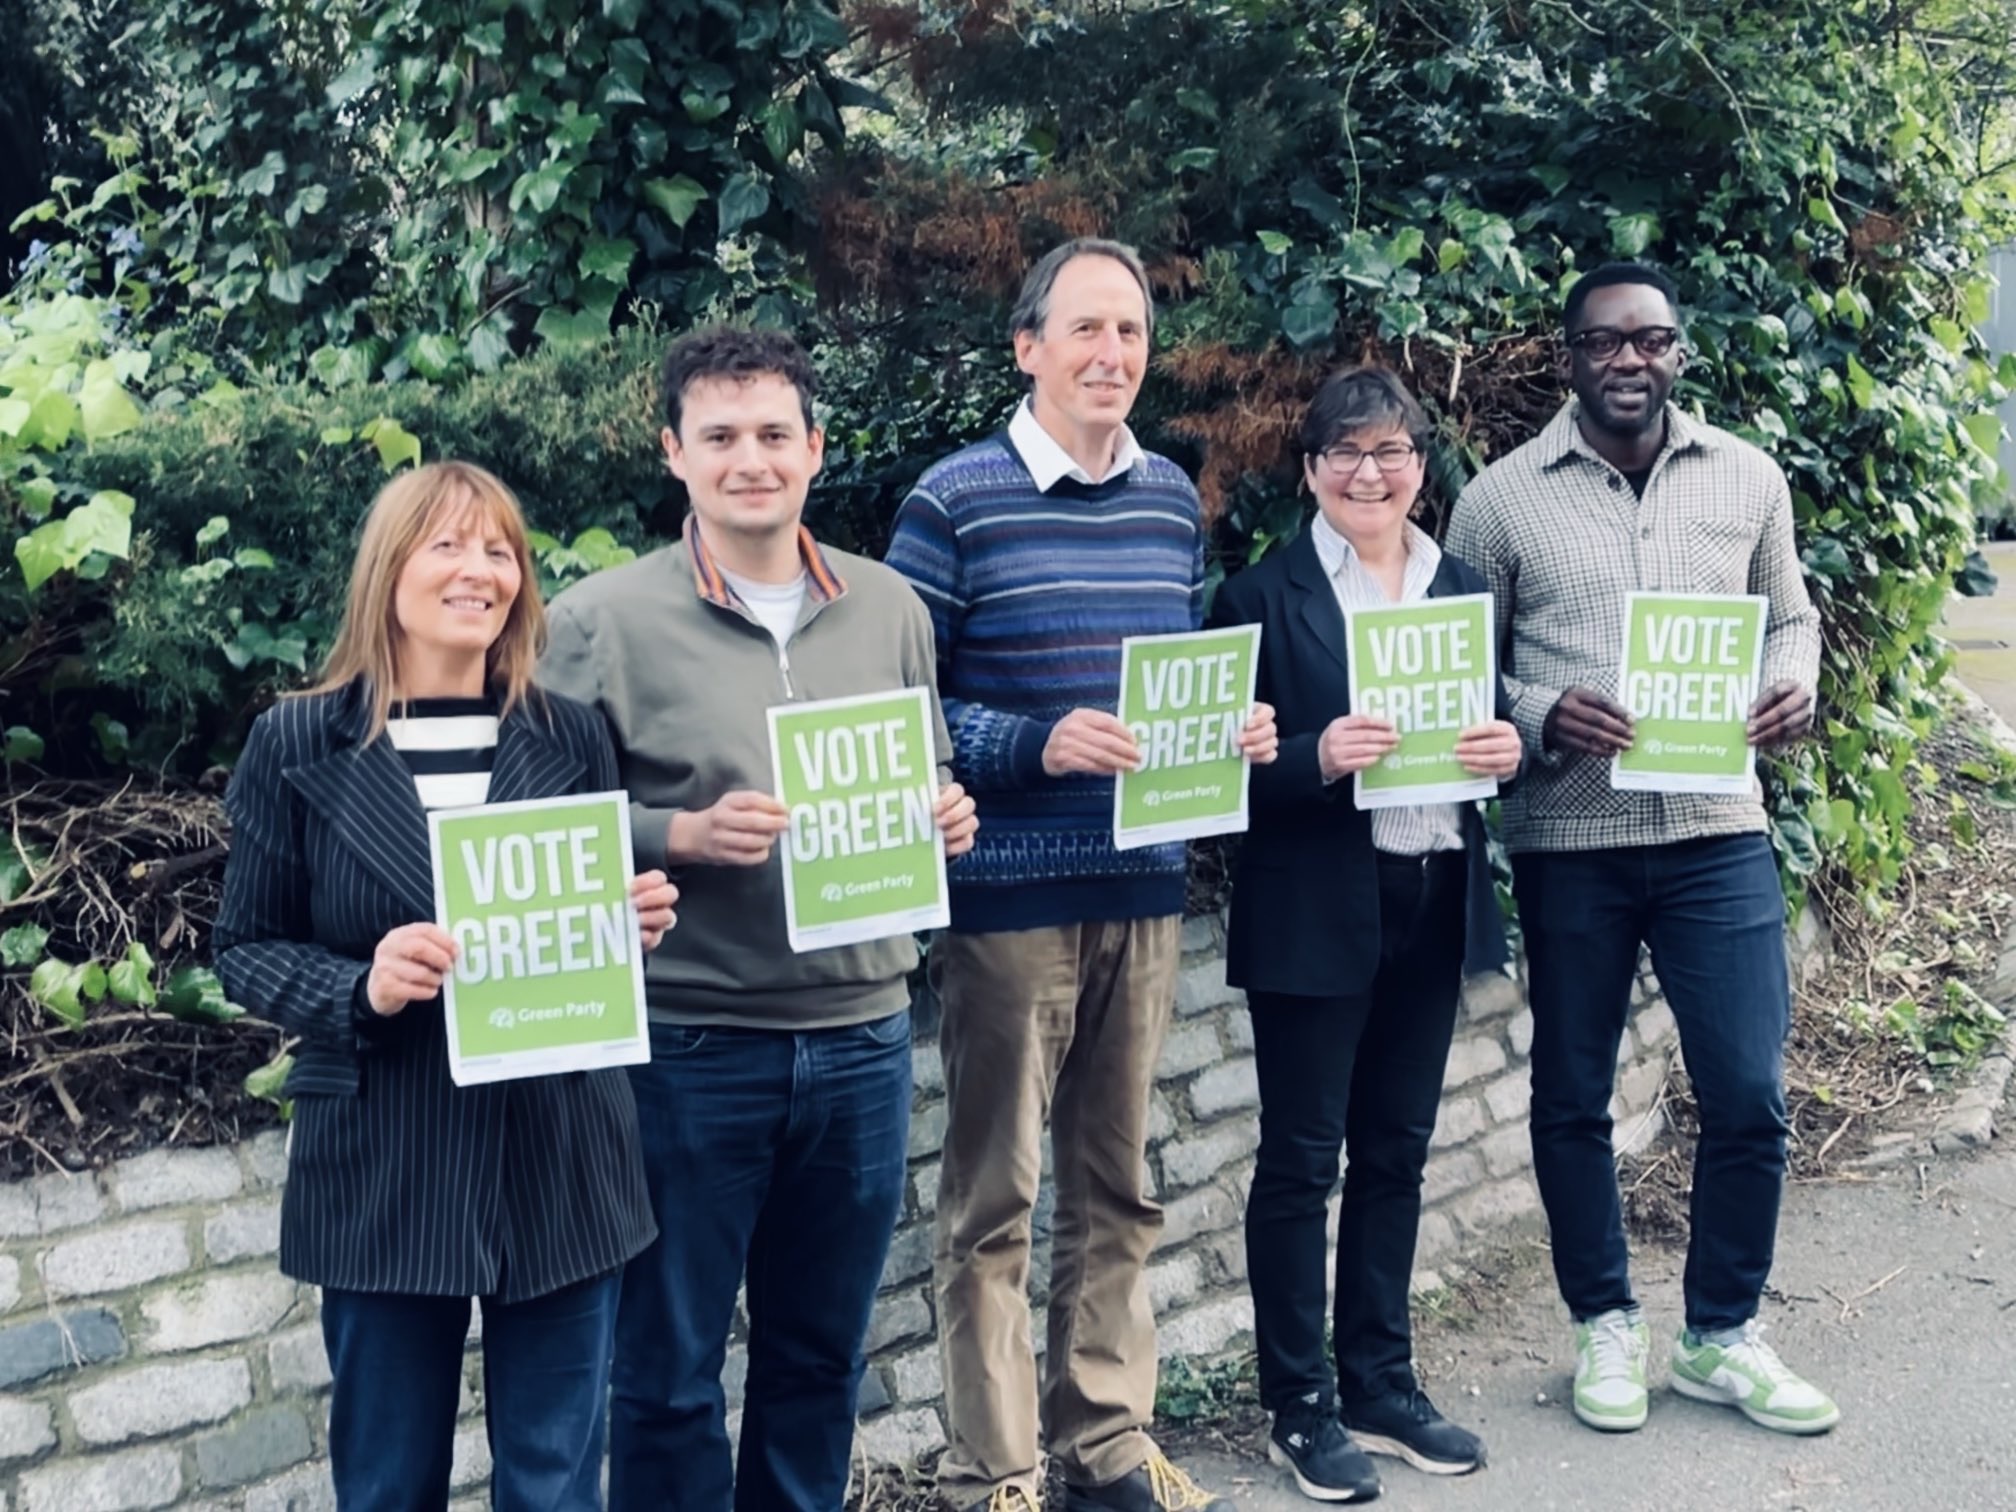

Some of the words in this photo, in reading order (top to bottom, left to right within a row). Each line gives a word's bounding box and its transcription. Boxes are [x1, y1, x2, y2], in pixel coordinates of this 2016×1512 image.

[1368, 619, 1472, 678] VOTE
[1645, 614, 1743, 666] VOTE
[1142, 651, 1238, 711] VOTE
[1628, 670, 1750, 722] GREEN
[794, 717, 912, 792] VOTE
[1403, 754, 1438, 767] Green
[1663, 742, 1697, 754] Green
[1699, 743, 1729, 758] Party
[1162, 788, 1193, 802] Green
[1195, 784, 1222, 799] Party
[790, 784, 934, 863] GREEN
[460, 826, 604, 906] VOTE
[845, 881, 881, 896] Green
[883, 873, 914, 889] Party
[452, 901, 629, 985] GREEN
[518, 1006, 563, 1022] Green
[566, 1001, 606, 1019] Party
